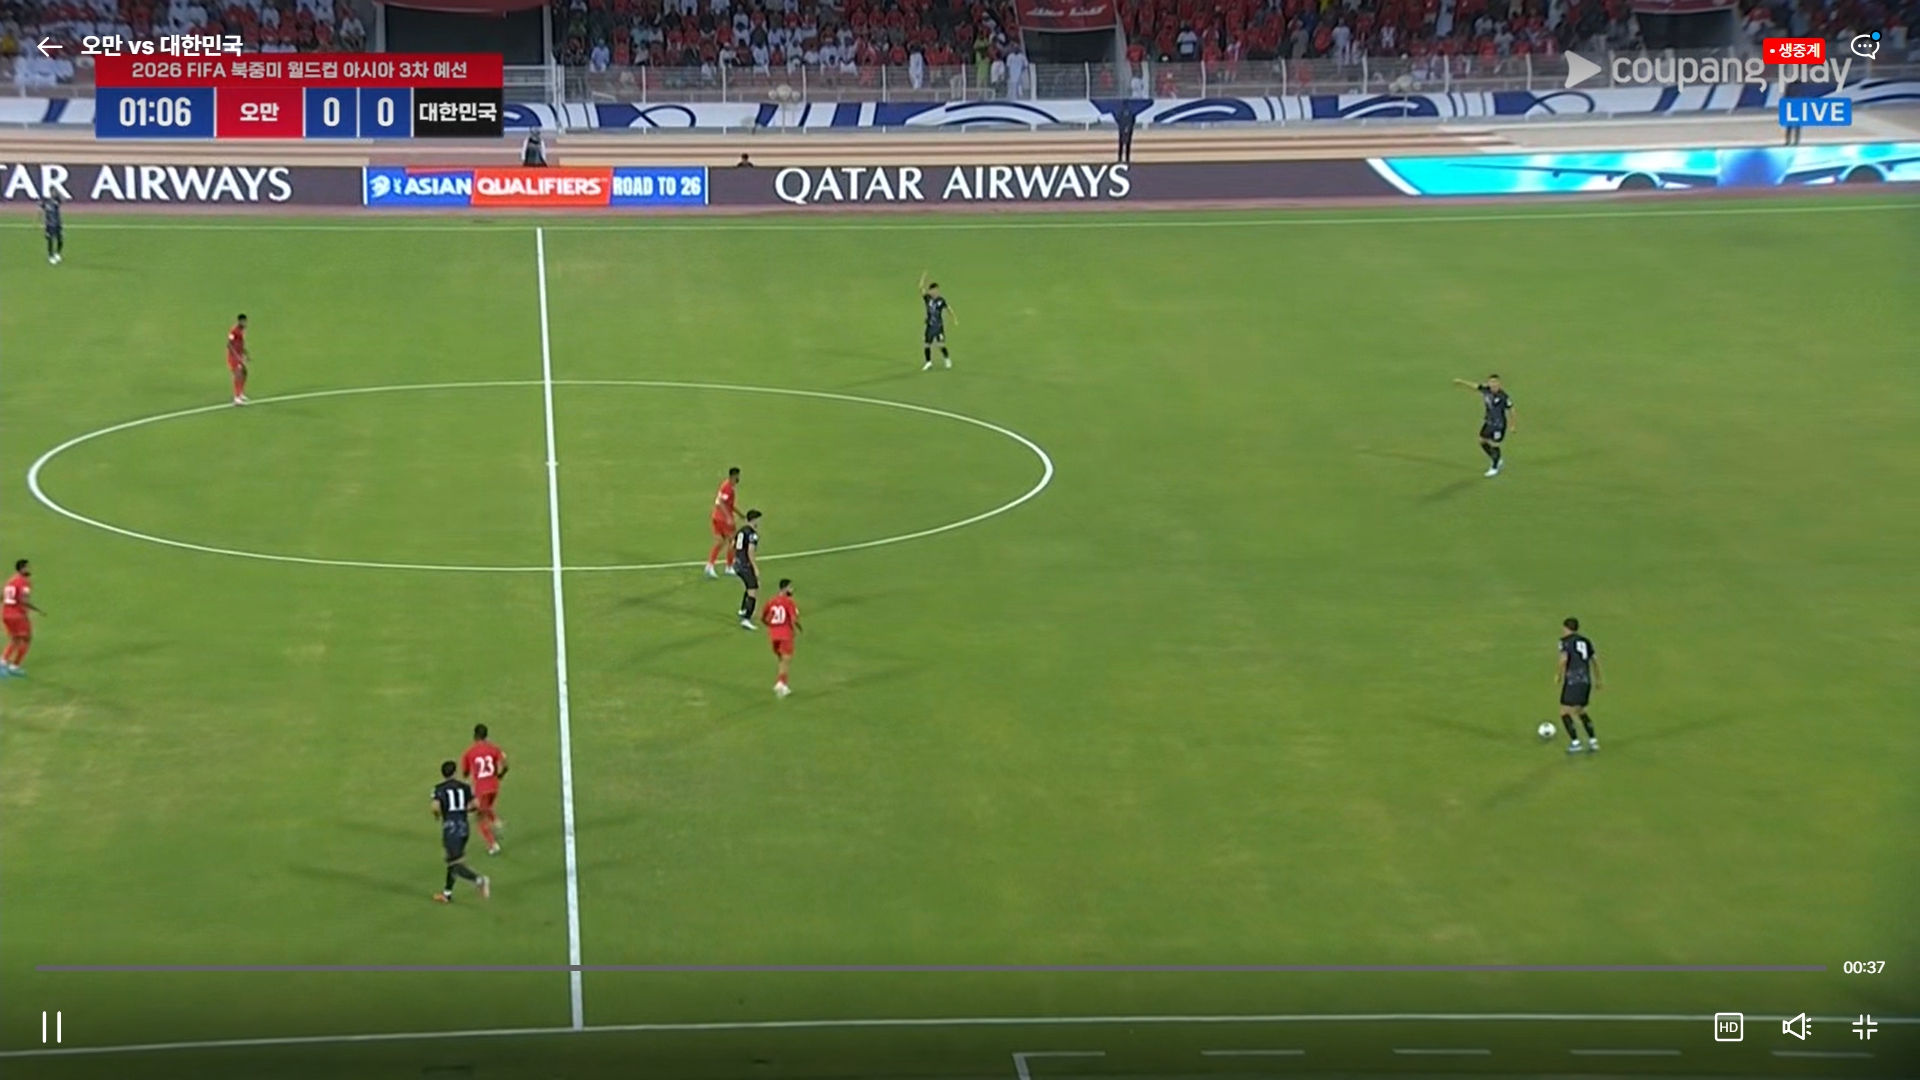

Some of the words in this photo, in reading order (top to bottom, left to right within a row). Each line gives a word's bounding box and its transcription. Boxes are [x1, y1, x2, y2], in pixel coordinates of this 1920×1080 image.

[91, 164, 292, 201] AIRWAYS
[404, 177, 472, 195] ASIAN
[477, 177, 602, 195] QUALIFIERS
[613, 177, 653, 195] ROAD
[657, 176, 679, 195] TO
[681, 176, 701, 195] 26
[775, 165, 924, 204] QATAR
[943, 163, 1131, 201] AIRWAYS
[770, 605, 786, 625] 20
[474, 755, 495, 779] 23
[446, 788, 465, 812] 11
